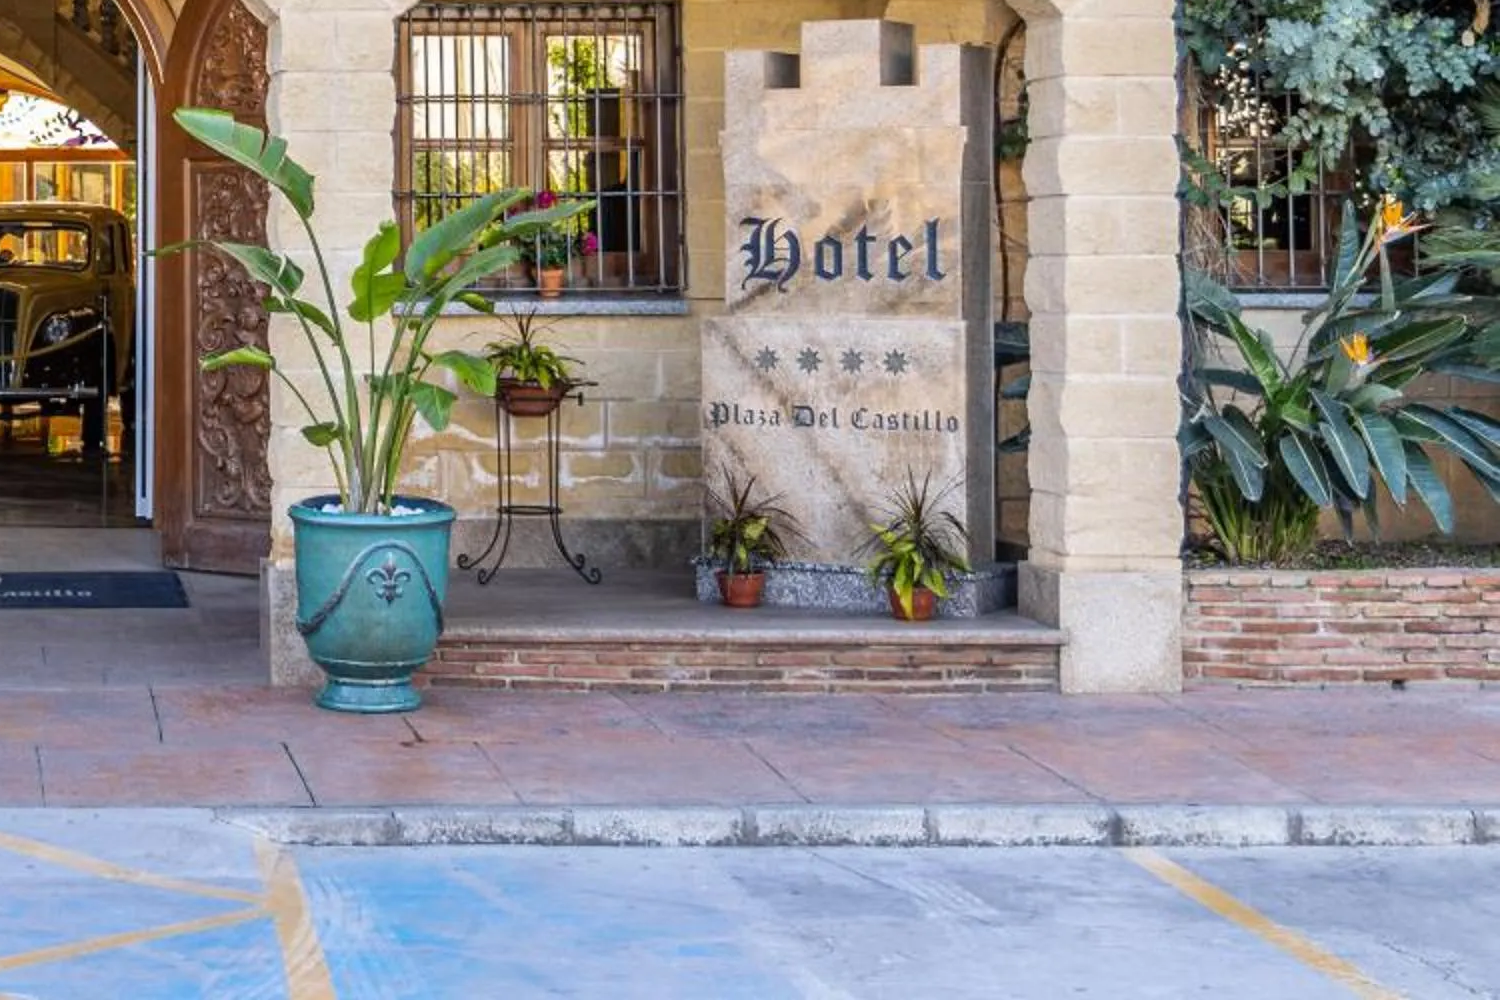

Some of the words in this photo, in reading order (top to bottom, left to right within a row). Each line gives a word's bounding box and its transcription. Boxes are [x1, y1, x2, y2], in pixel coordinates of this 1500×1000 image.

[739, 216, 946, 293] Hotel
[709, 401, 781, 429] Plaza
[791, 404, 840, 430] Del
[850, 406, 960, 433] Castillo
